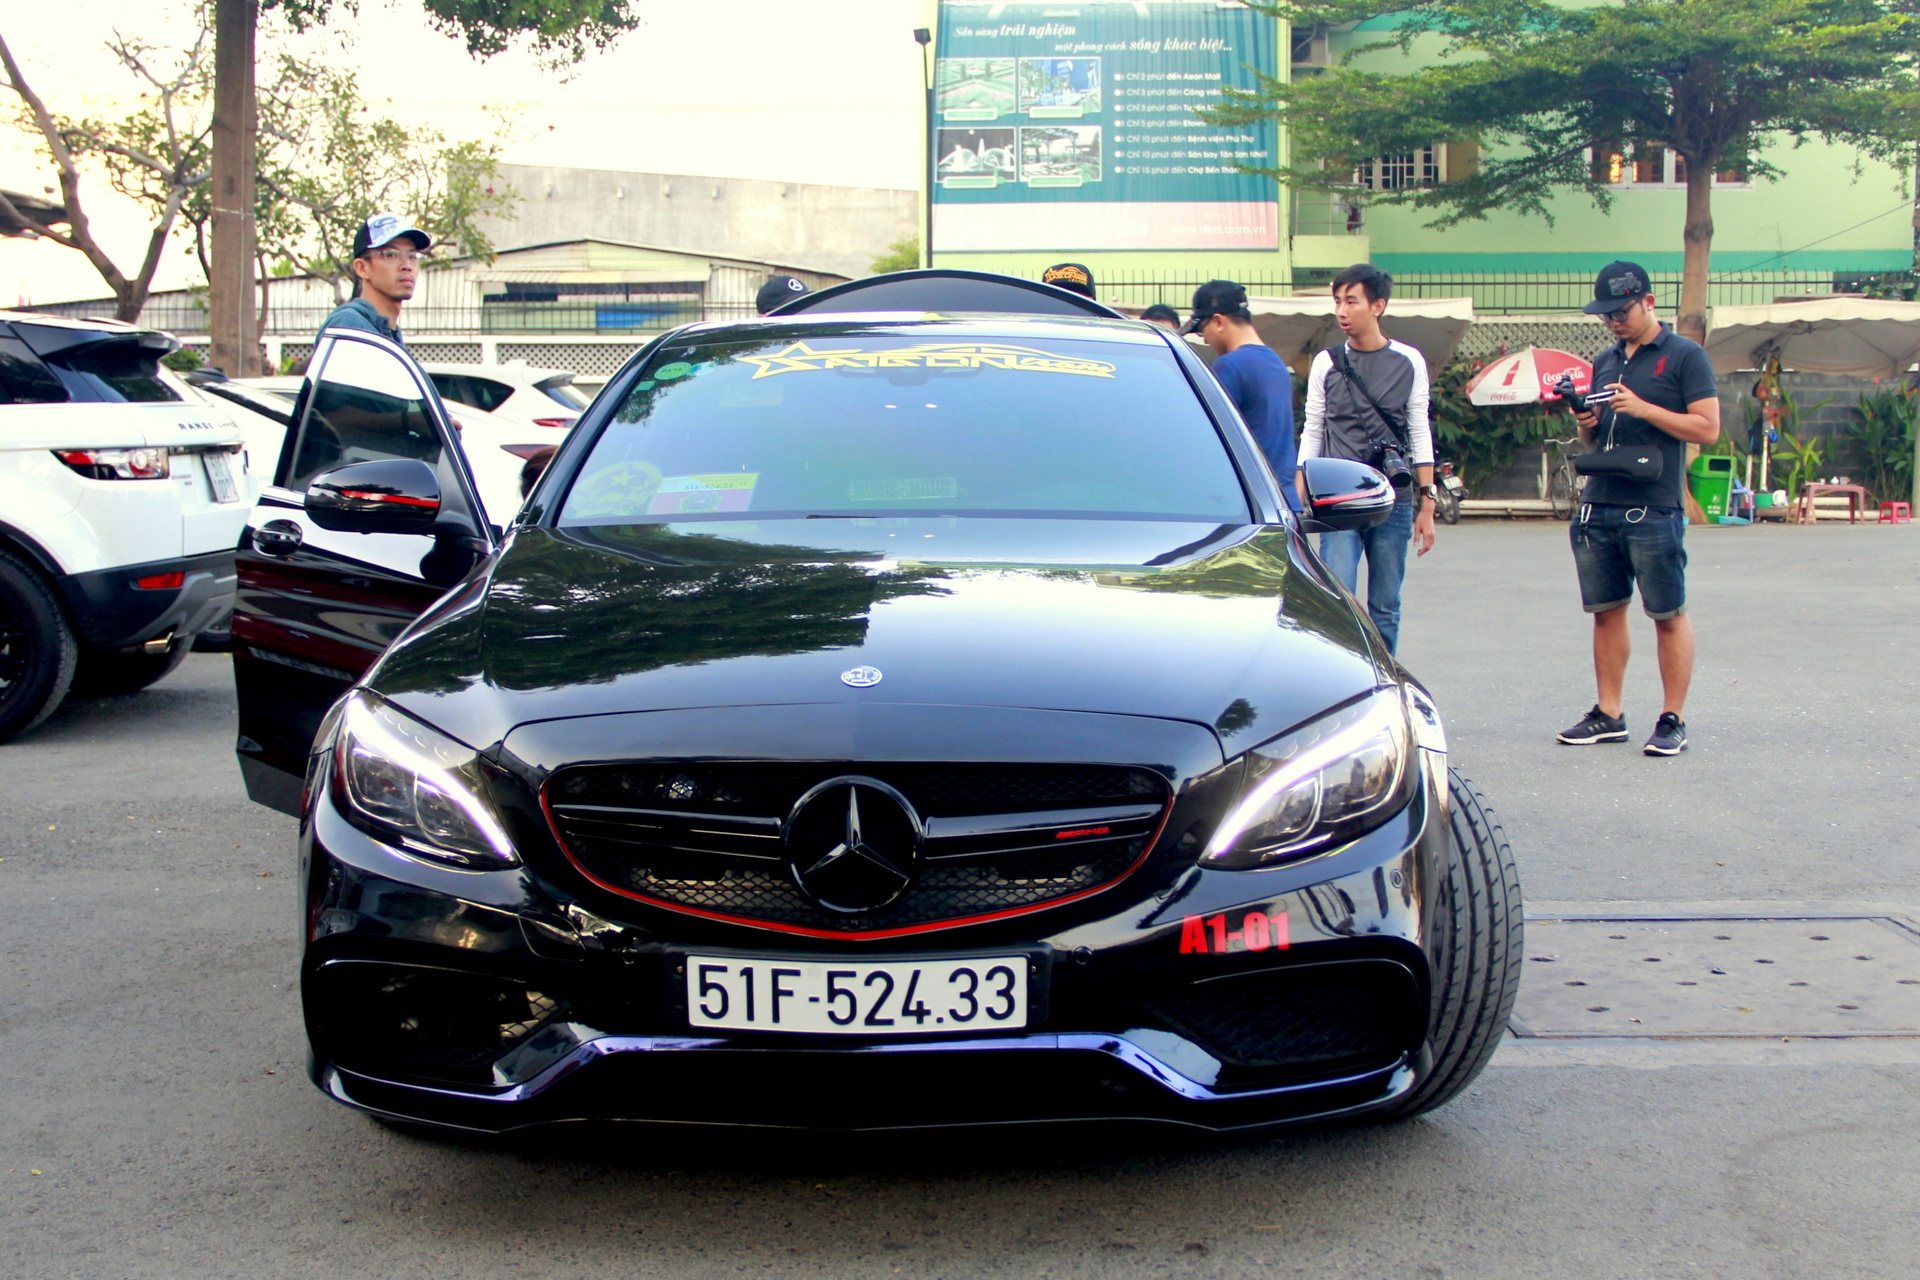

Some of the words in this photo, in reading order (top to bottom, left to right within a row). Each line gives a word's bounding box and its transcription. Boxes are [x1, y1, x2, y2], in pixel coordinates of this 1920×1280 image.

[1028, 23, 1076, 38] nghiệm
[1073, 42, 1103, 53] phong
[1129, 38, 1160, 53] sống
[1163, 38, 1196, 51] khác
[1204, 151, 1218, 160] bay
[1179, 911, 1290, 954] A1-01
[698, 963, 1016, 1026] 51F-524.33
